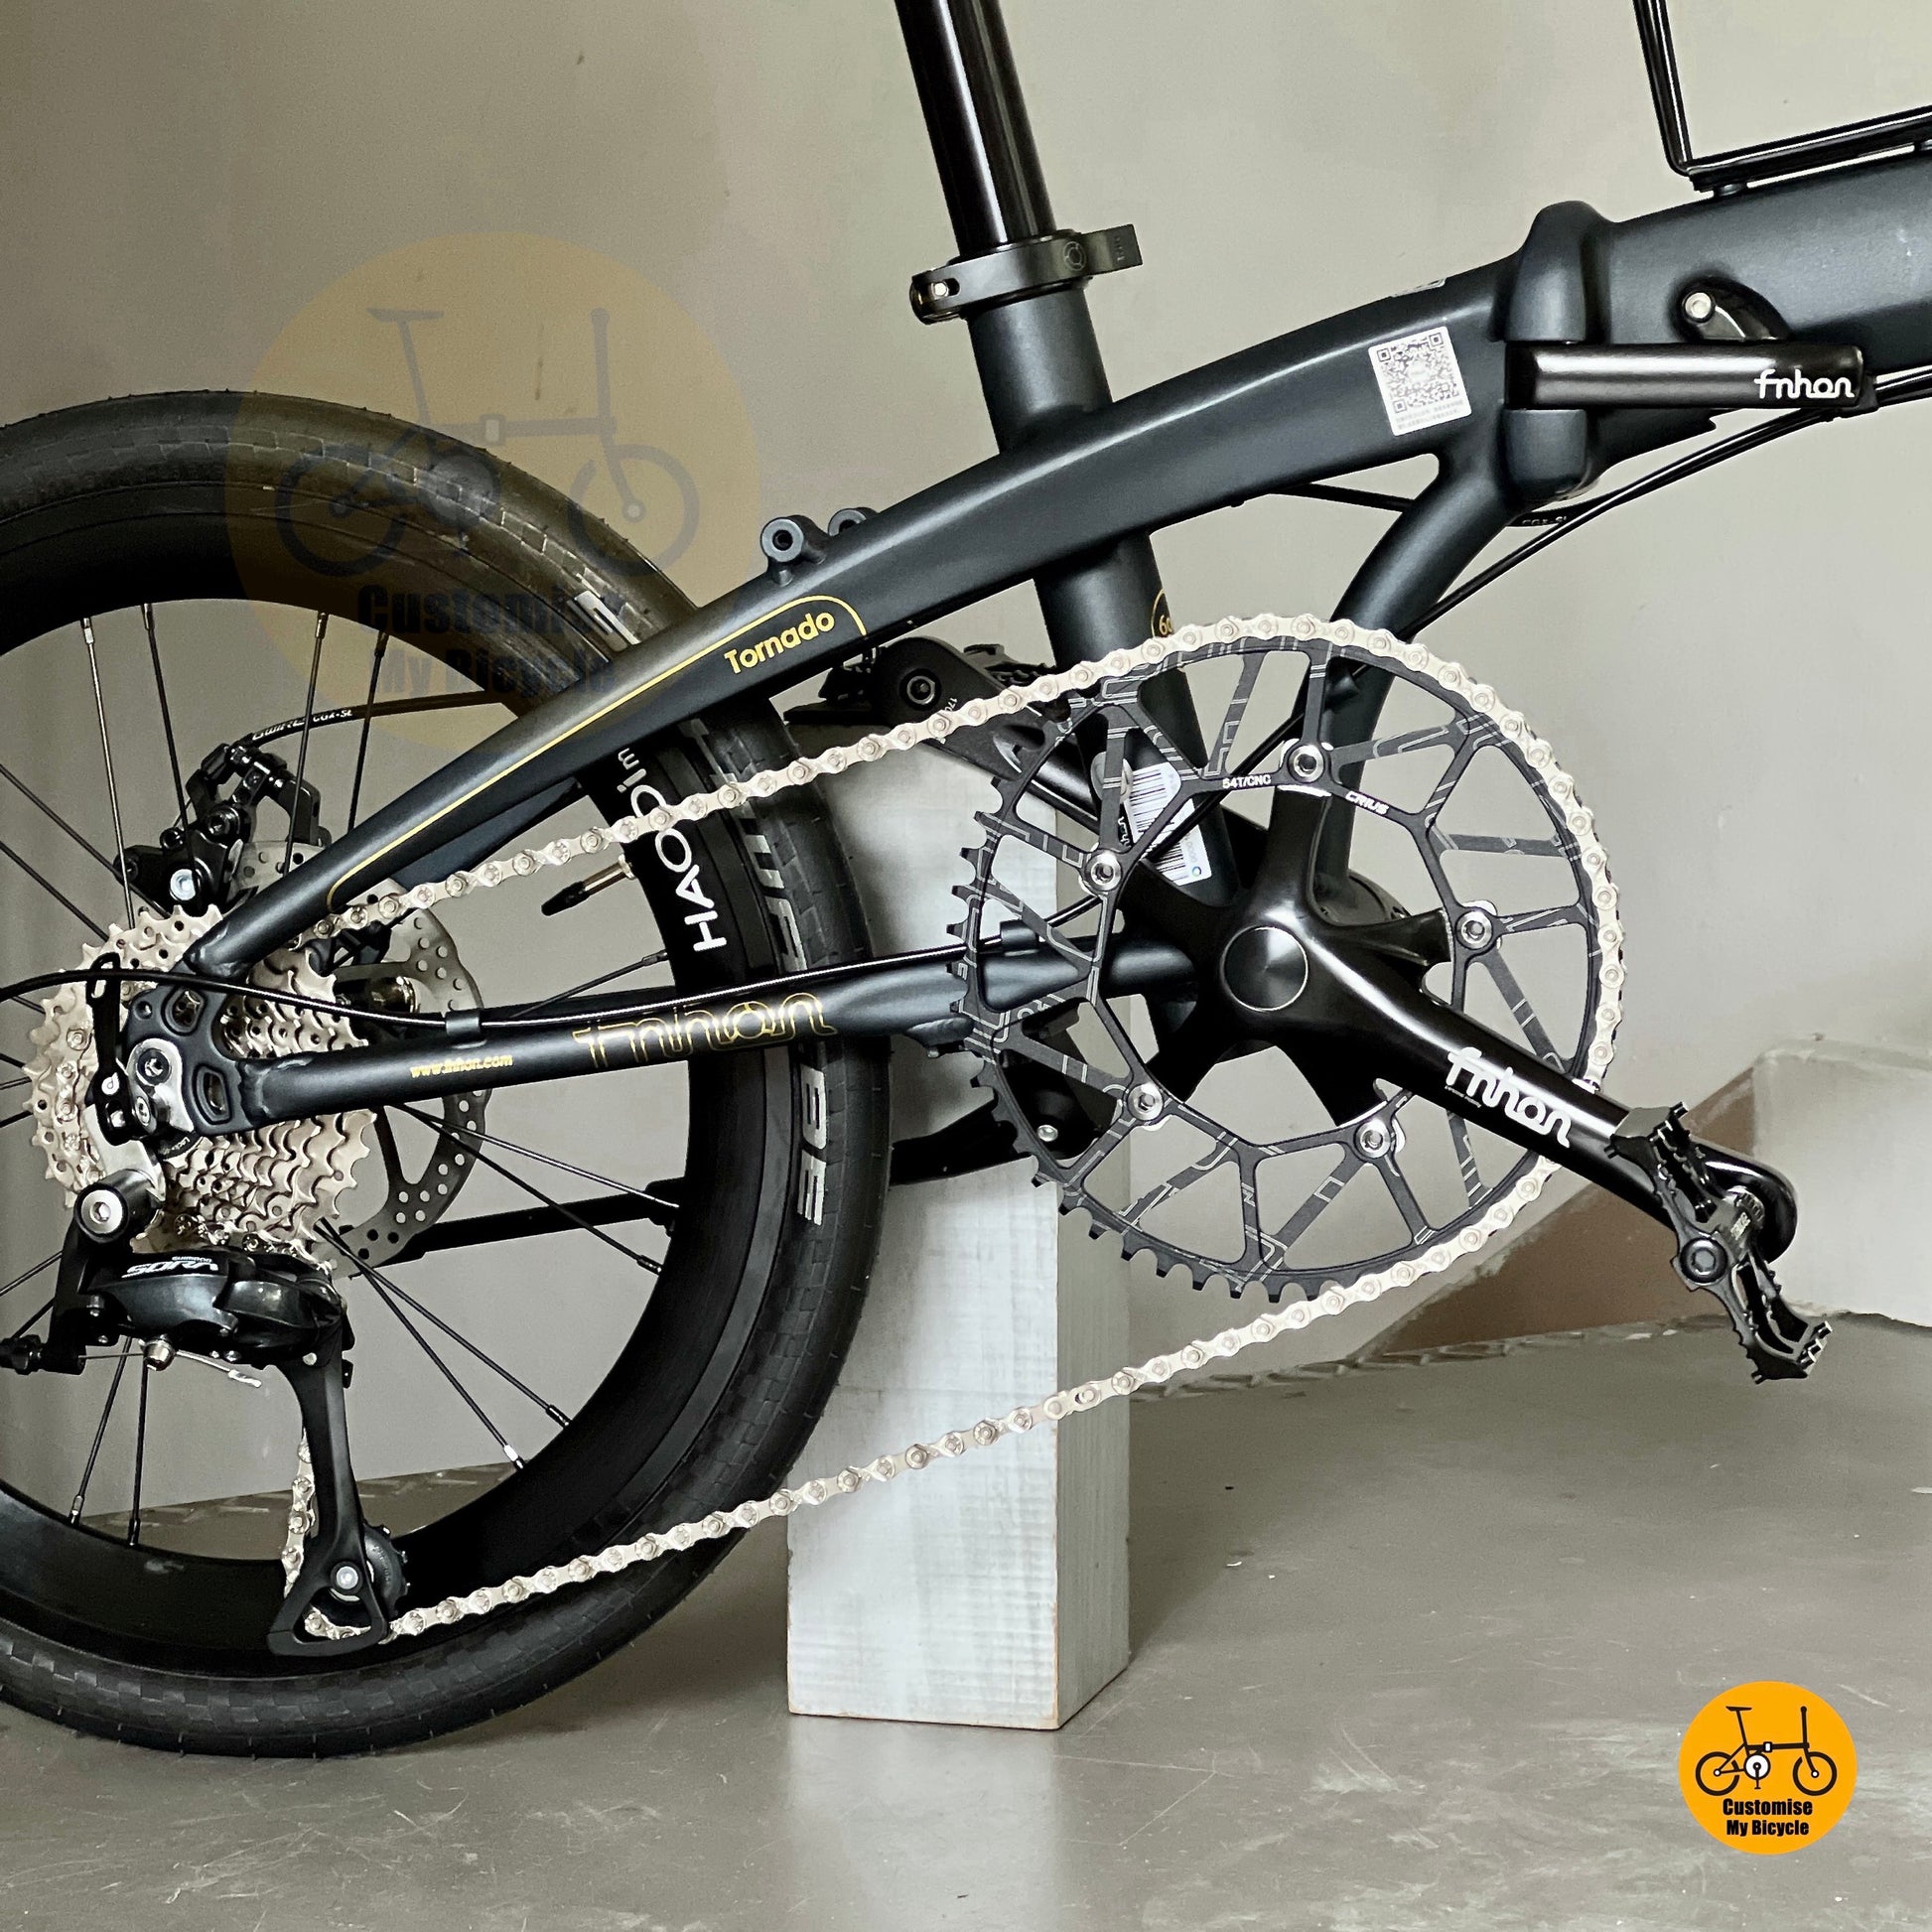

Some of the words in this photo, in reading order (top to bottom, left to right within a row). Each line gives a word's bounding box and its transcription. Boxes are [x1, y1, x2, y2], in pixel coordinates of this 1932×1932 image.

[1753, 368, 1856, 399] fnhon
[724, 612, 835, 674] Tornado
[1345, 790, 1390, 815] CRIUS
[1446, 1046, 1571, 1149] fnhon
[121, 1260, 218, 1279] SORA
